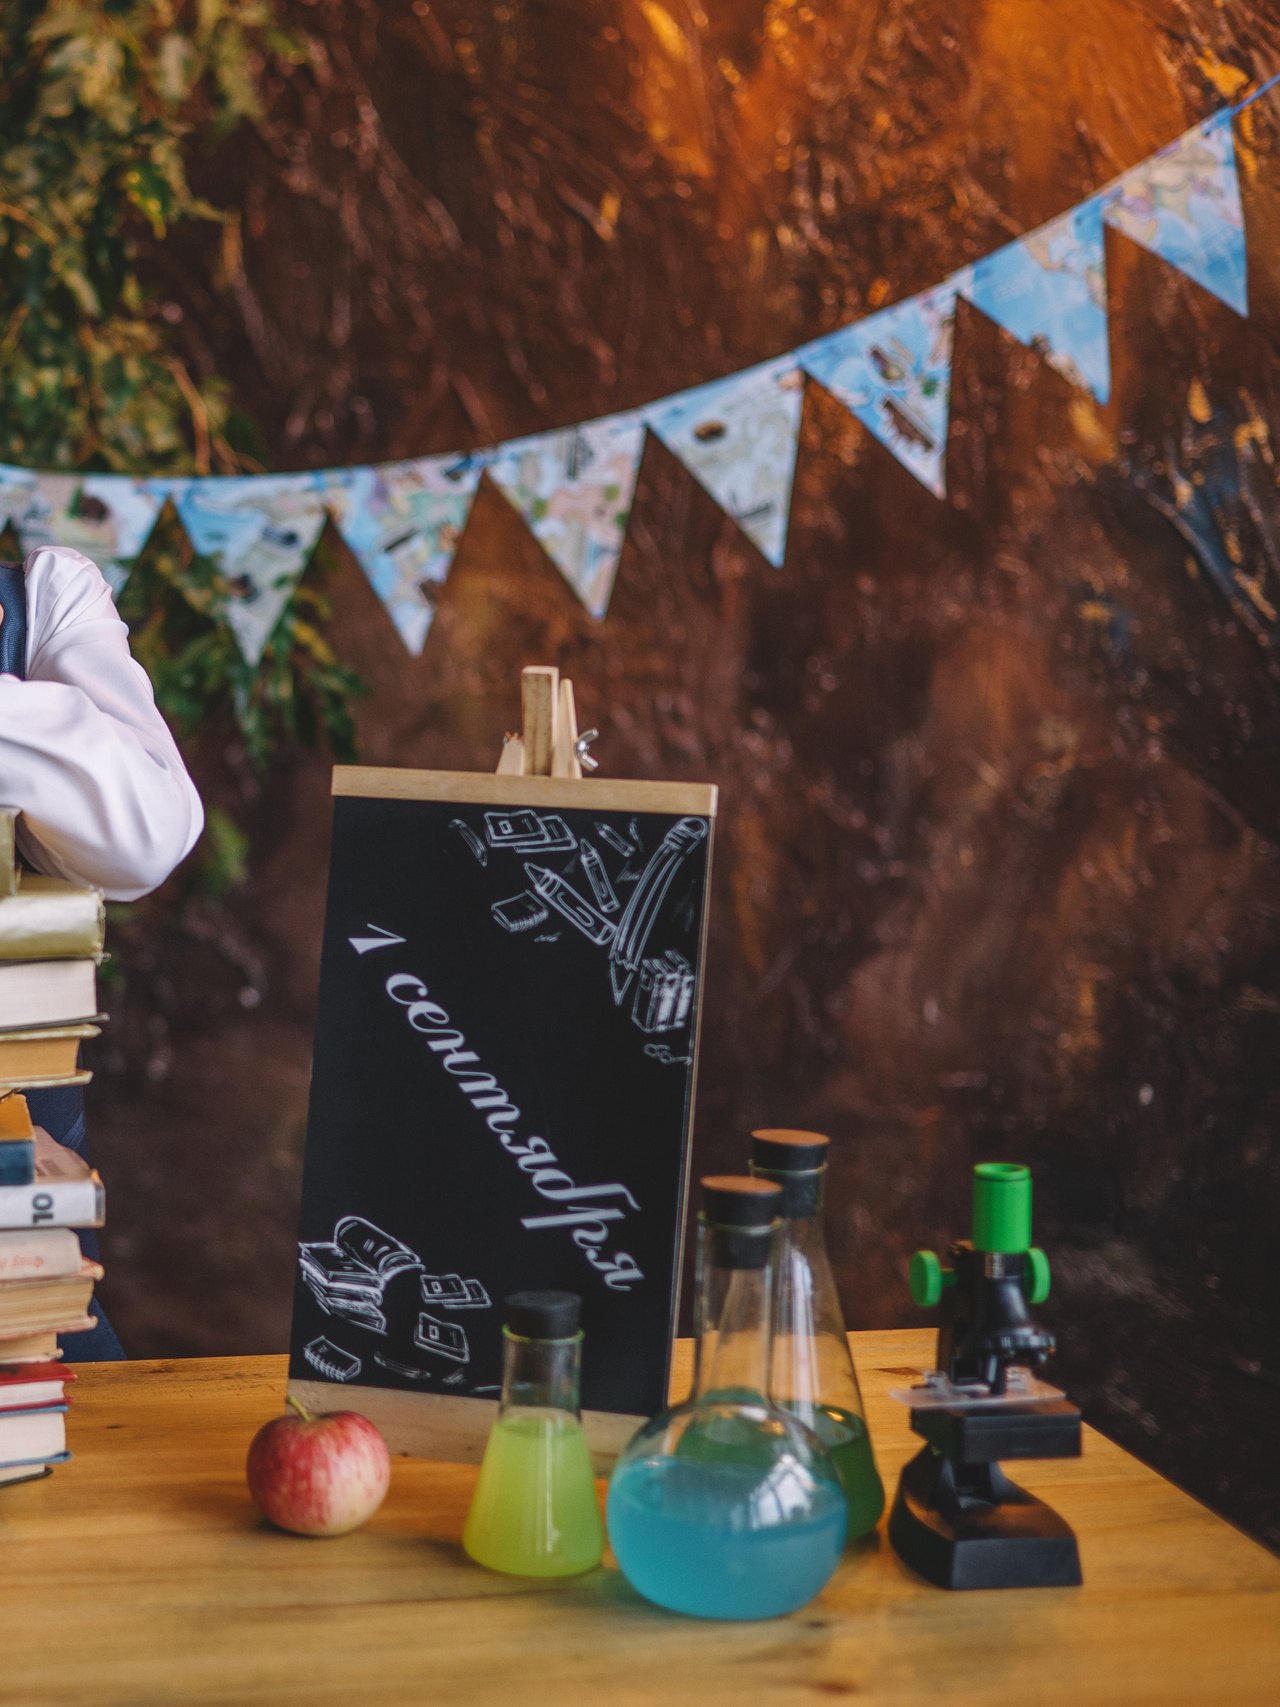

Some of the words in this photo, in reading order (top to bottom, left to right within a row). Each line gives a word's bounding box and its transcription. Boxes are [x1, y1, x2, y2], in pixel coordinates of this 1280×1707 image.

[347, 923, 408, 955] 1
[385, 972, 646, 1292] сентября
[32, 1192, 54, 1224] 10
